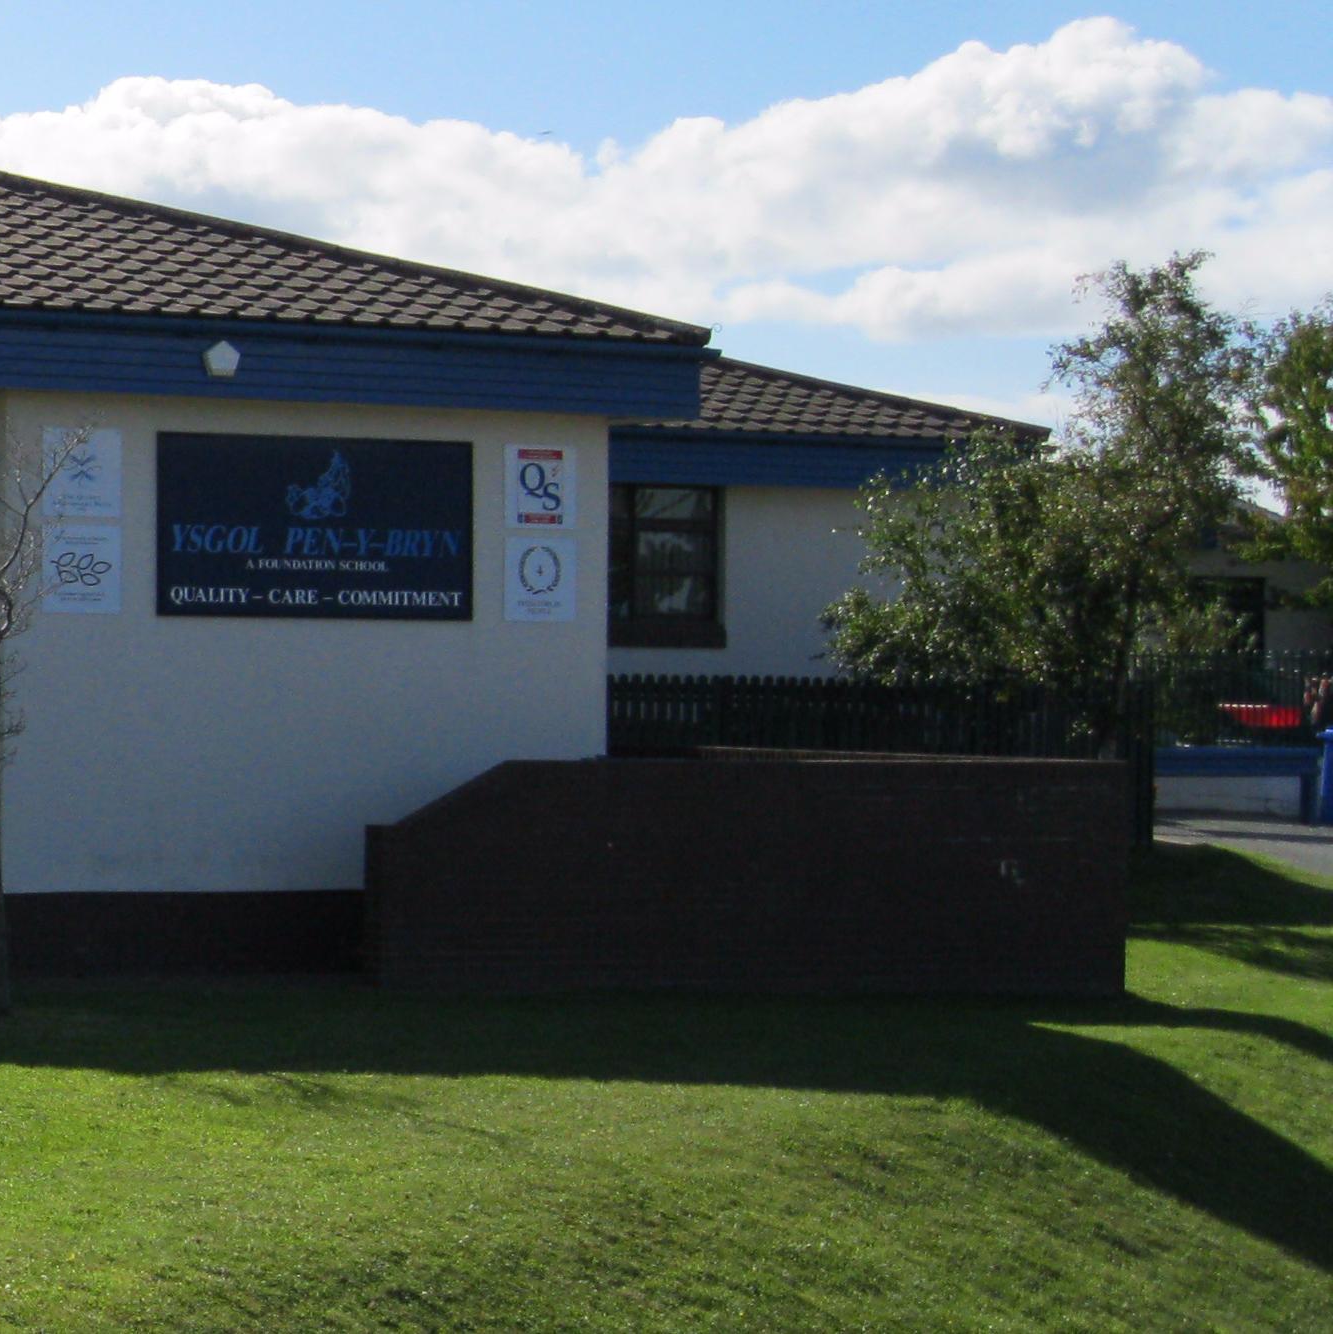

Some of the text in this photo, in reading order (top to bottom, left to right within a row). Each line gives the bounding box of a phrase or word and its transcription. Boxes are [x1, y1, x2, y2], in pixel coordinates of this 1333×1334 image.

[171, 524, 460, 558] YSGOL PEN-Y-BRYN
[245, 559, 388, 571] A FOUNDATION SCHOOL
[170, 586, 249, 604] QUALITY
[268, 588, 318, 605] CARE
[338, 590, 461, 606] COMMITMENT
